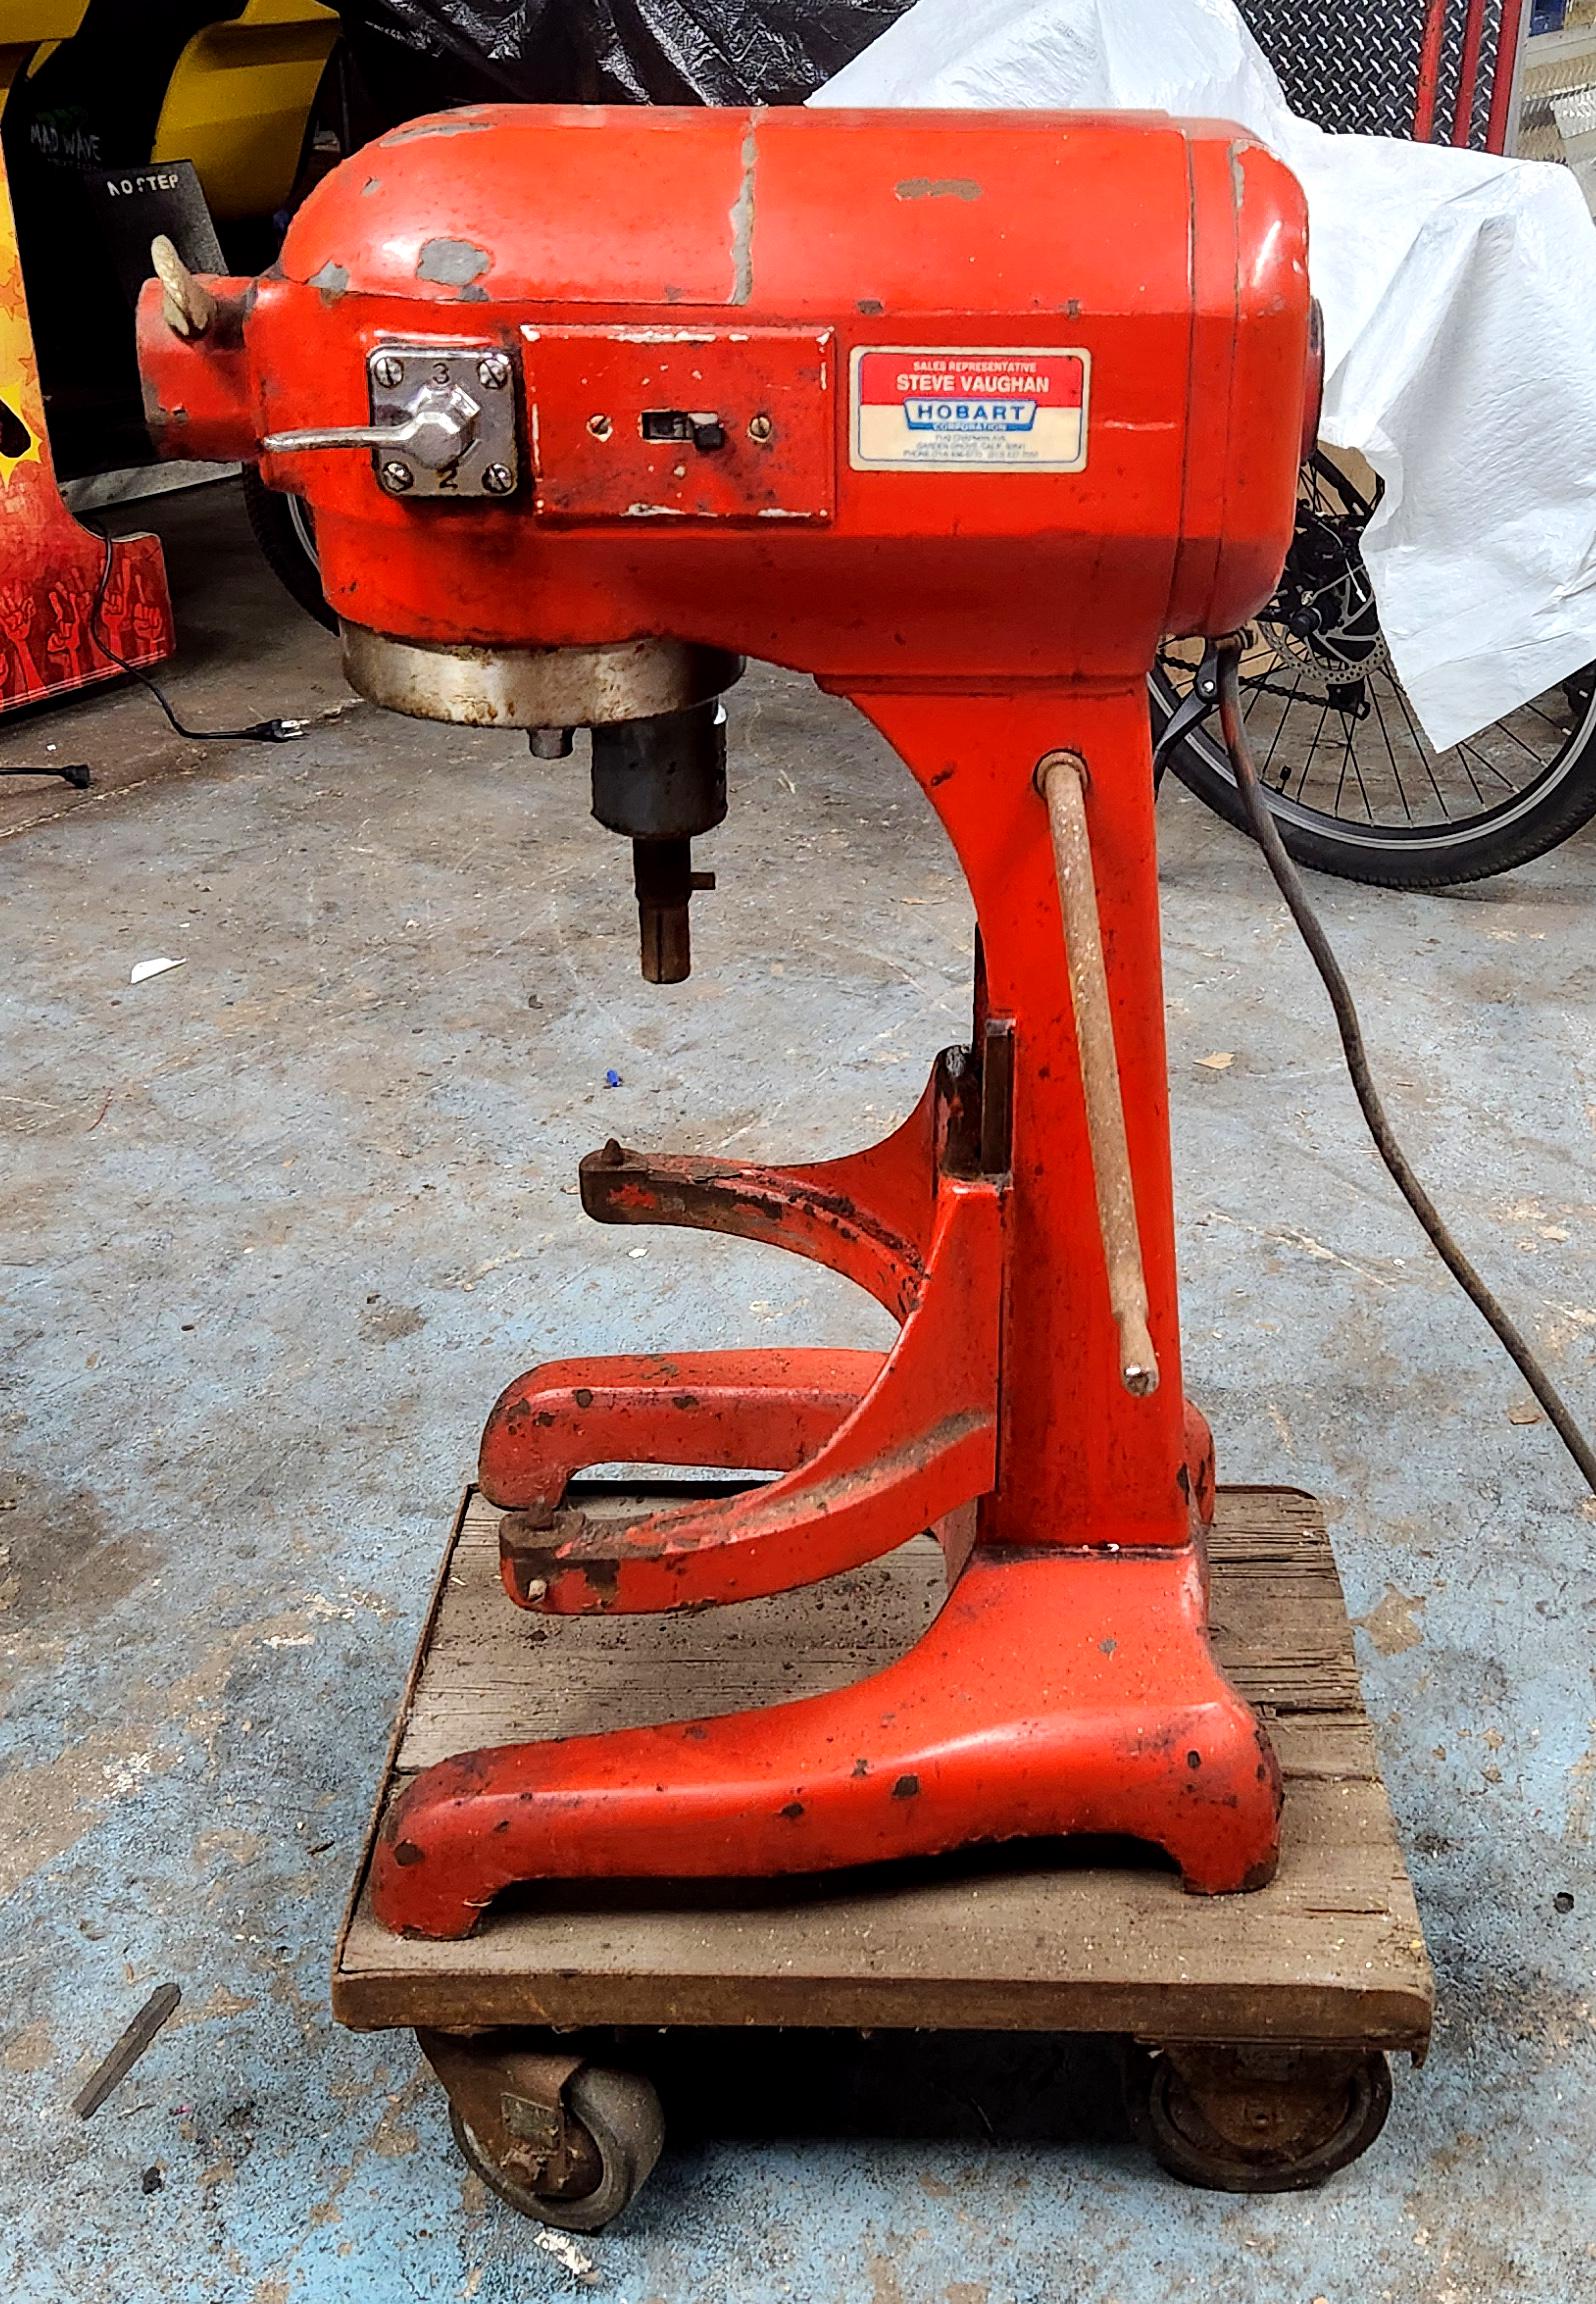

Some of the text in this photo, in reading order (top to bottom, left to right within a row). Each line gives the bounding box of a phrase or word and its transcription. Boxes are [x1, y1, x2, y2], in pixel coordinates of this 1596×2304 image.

[63, 129, 103, 161] WAVE
[432, 362, 450, 384] 3
[913, 361, 1038, 373] SALES REPRESENTATIVE
[896, 374, 1050, 393] STEVE VAUGHAN
[917, 404, 1026, 421] HOBART
[439, 466, 458, 490] 2
